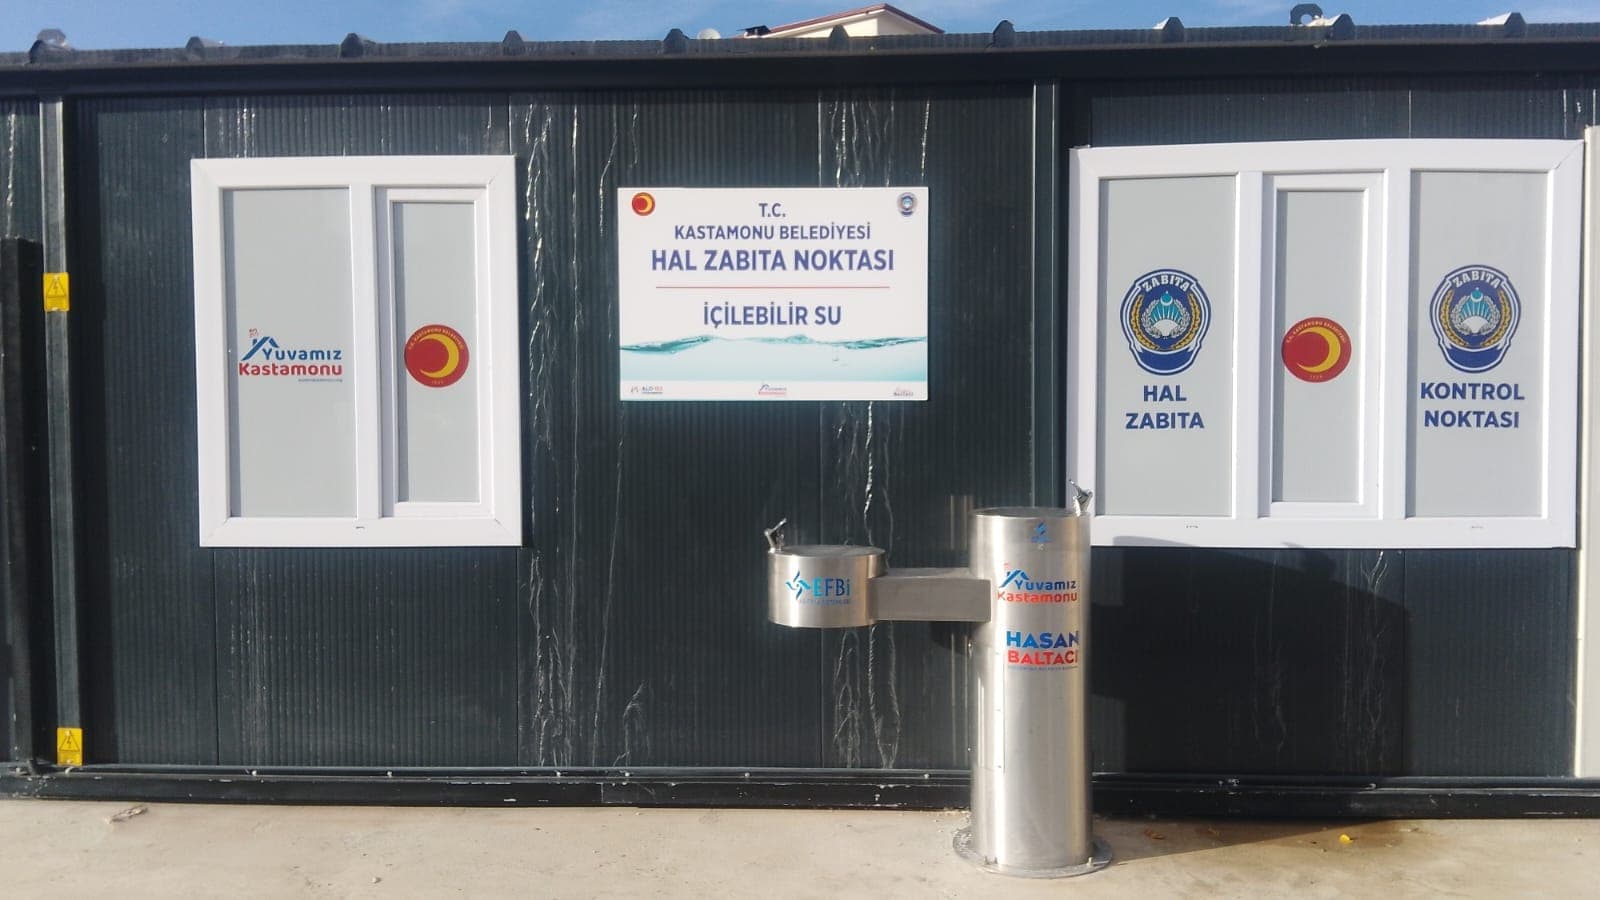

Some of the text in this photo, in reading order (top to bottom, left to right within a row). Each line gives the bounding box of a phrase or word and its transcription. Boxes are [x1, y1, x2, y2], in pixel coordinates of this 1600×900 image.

[759, 202, 786, 217] T.C.
[674, 221, 871, 240] KASTAMONU BELEDİYESİ
[651, 249, 894, 271] HAL ZABITA NOKTASI
[1142, 274, 1190, 292] ZABITA
[1451, 270, 1501, 289] ZABITA
[703, 301, 842, 328] İÇİLEBİLİR SU
[262, 348, 342, 361] Yuvamız
[239, 362, 343, 376] Kastamonu
[1143, 384, 1187, 402] HAL
[1420, 382, 1525, 401] KONTROL
[1125, 412, 1205, 430] ZABITA
[1424, 410, 1520, 428] NOKTASI
[1014, 580, 1077, 591] Yuvamız
[997, 590, 1078, 603] Kastamonu
[1006, 630, 1080, 649] HASAN
[1008, 649, 1078, 665] BALTACI
